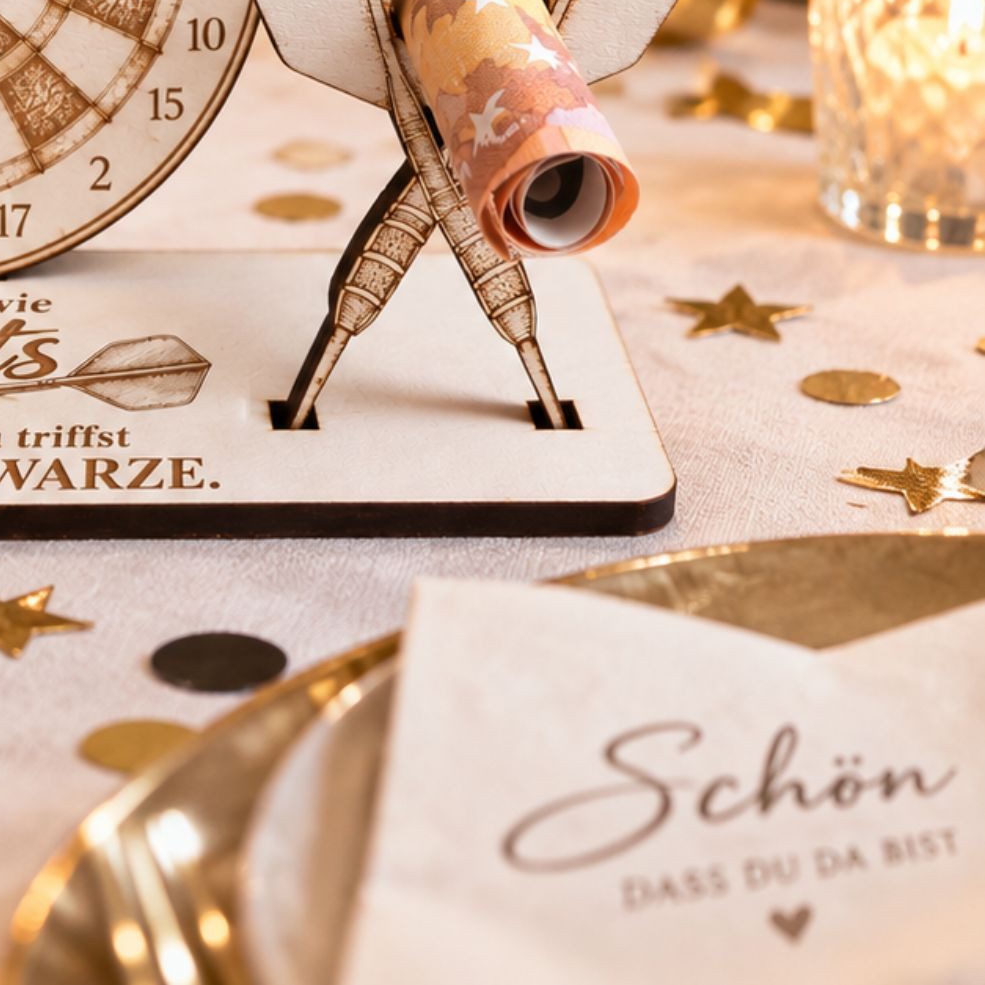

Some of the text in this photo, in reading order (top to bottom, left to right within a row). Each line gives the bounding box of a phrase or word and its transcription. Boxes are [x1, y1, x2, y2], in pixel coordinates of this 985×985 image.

[188, 17, 226, 52] 10
[148, 87, 185, 121] 15
[89, 155, 112, 192] 2
[17, 424, 130, 449] triffst
[500, 720, 957, 874] Schön
[621, 827, 959, 912] DASS DU DA BIST
